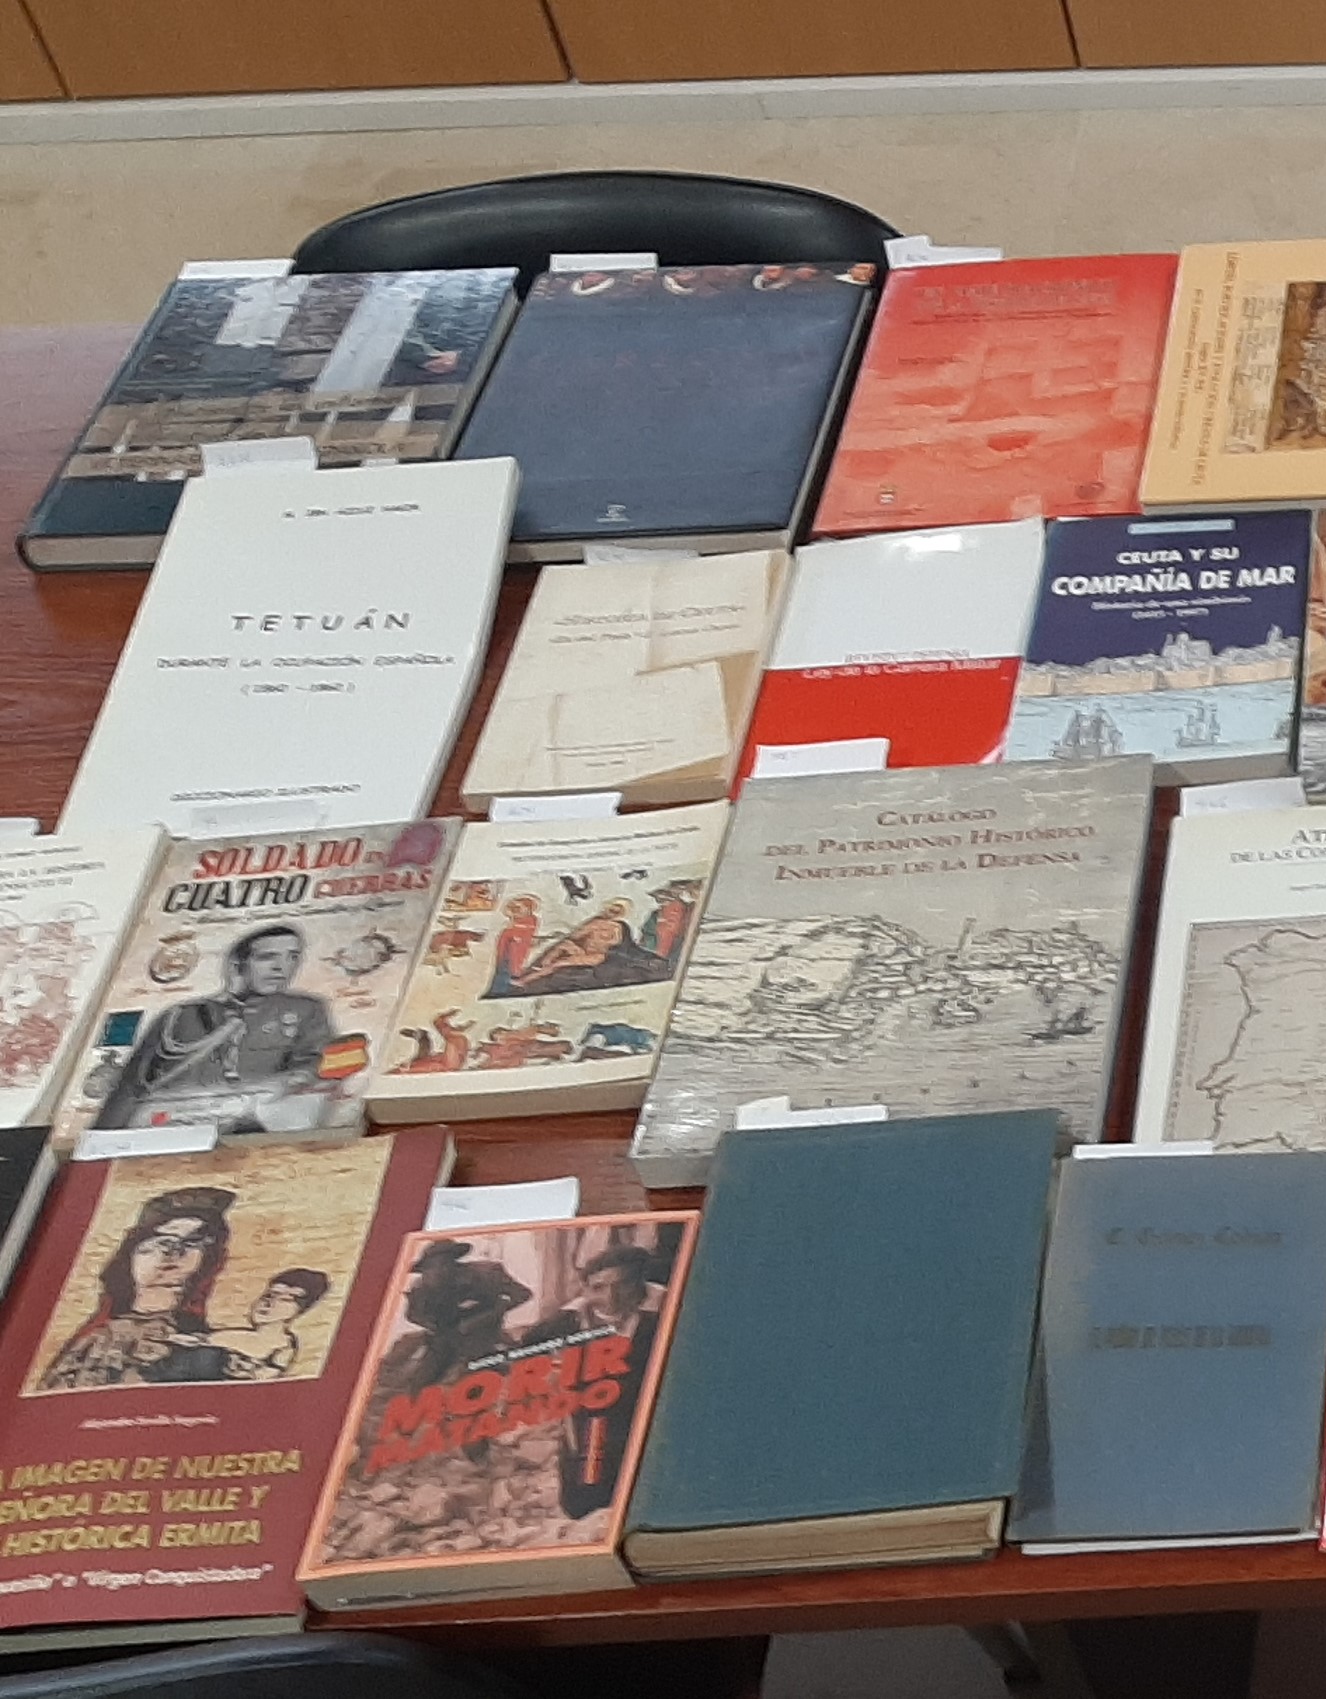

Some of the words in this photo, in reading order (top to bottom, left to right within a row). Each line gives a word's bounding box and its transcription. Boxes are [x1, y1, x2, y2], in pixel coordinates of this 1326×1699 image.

[1115, 548, 1184, 566] CEUTA
[1188, 547, 1207, 562] Y
[1209, 545, 1240, 561] SU
[1050, 566, 1193, 597] COMPAÑÍA
[1199, 569, 1232, 591] DE
[1235, 564, 1297, 589] MAR
[230, 607, 413, 633] TETUÁN
[192, 836, 365, 879] SOLDADO
[162, 872, 311, 913] CUATRO
[378, 1335, 634, 1441] MORIR
[8, 1456, 130, 1490] IMAGEN
[130, 1456, 170, 1481] DE
[172, 1449, 301, 1480] NUESTRA
[0, 1491, 94, 1526] EÑORA
[97, 1490, 152, 1515] DEL
[160, 1486, 244, 1514] VALLE
[248, 1484, 271, 1510] Y
[3, 1519, 151, 1557] HISTÓRICA
[157, 1517, 264, 1549] ERMITA
